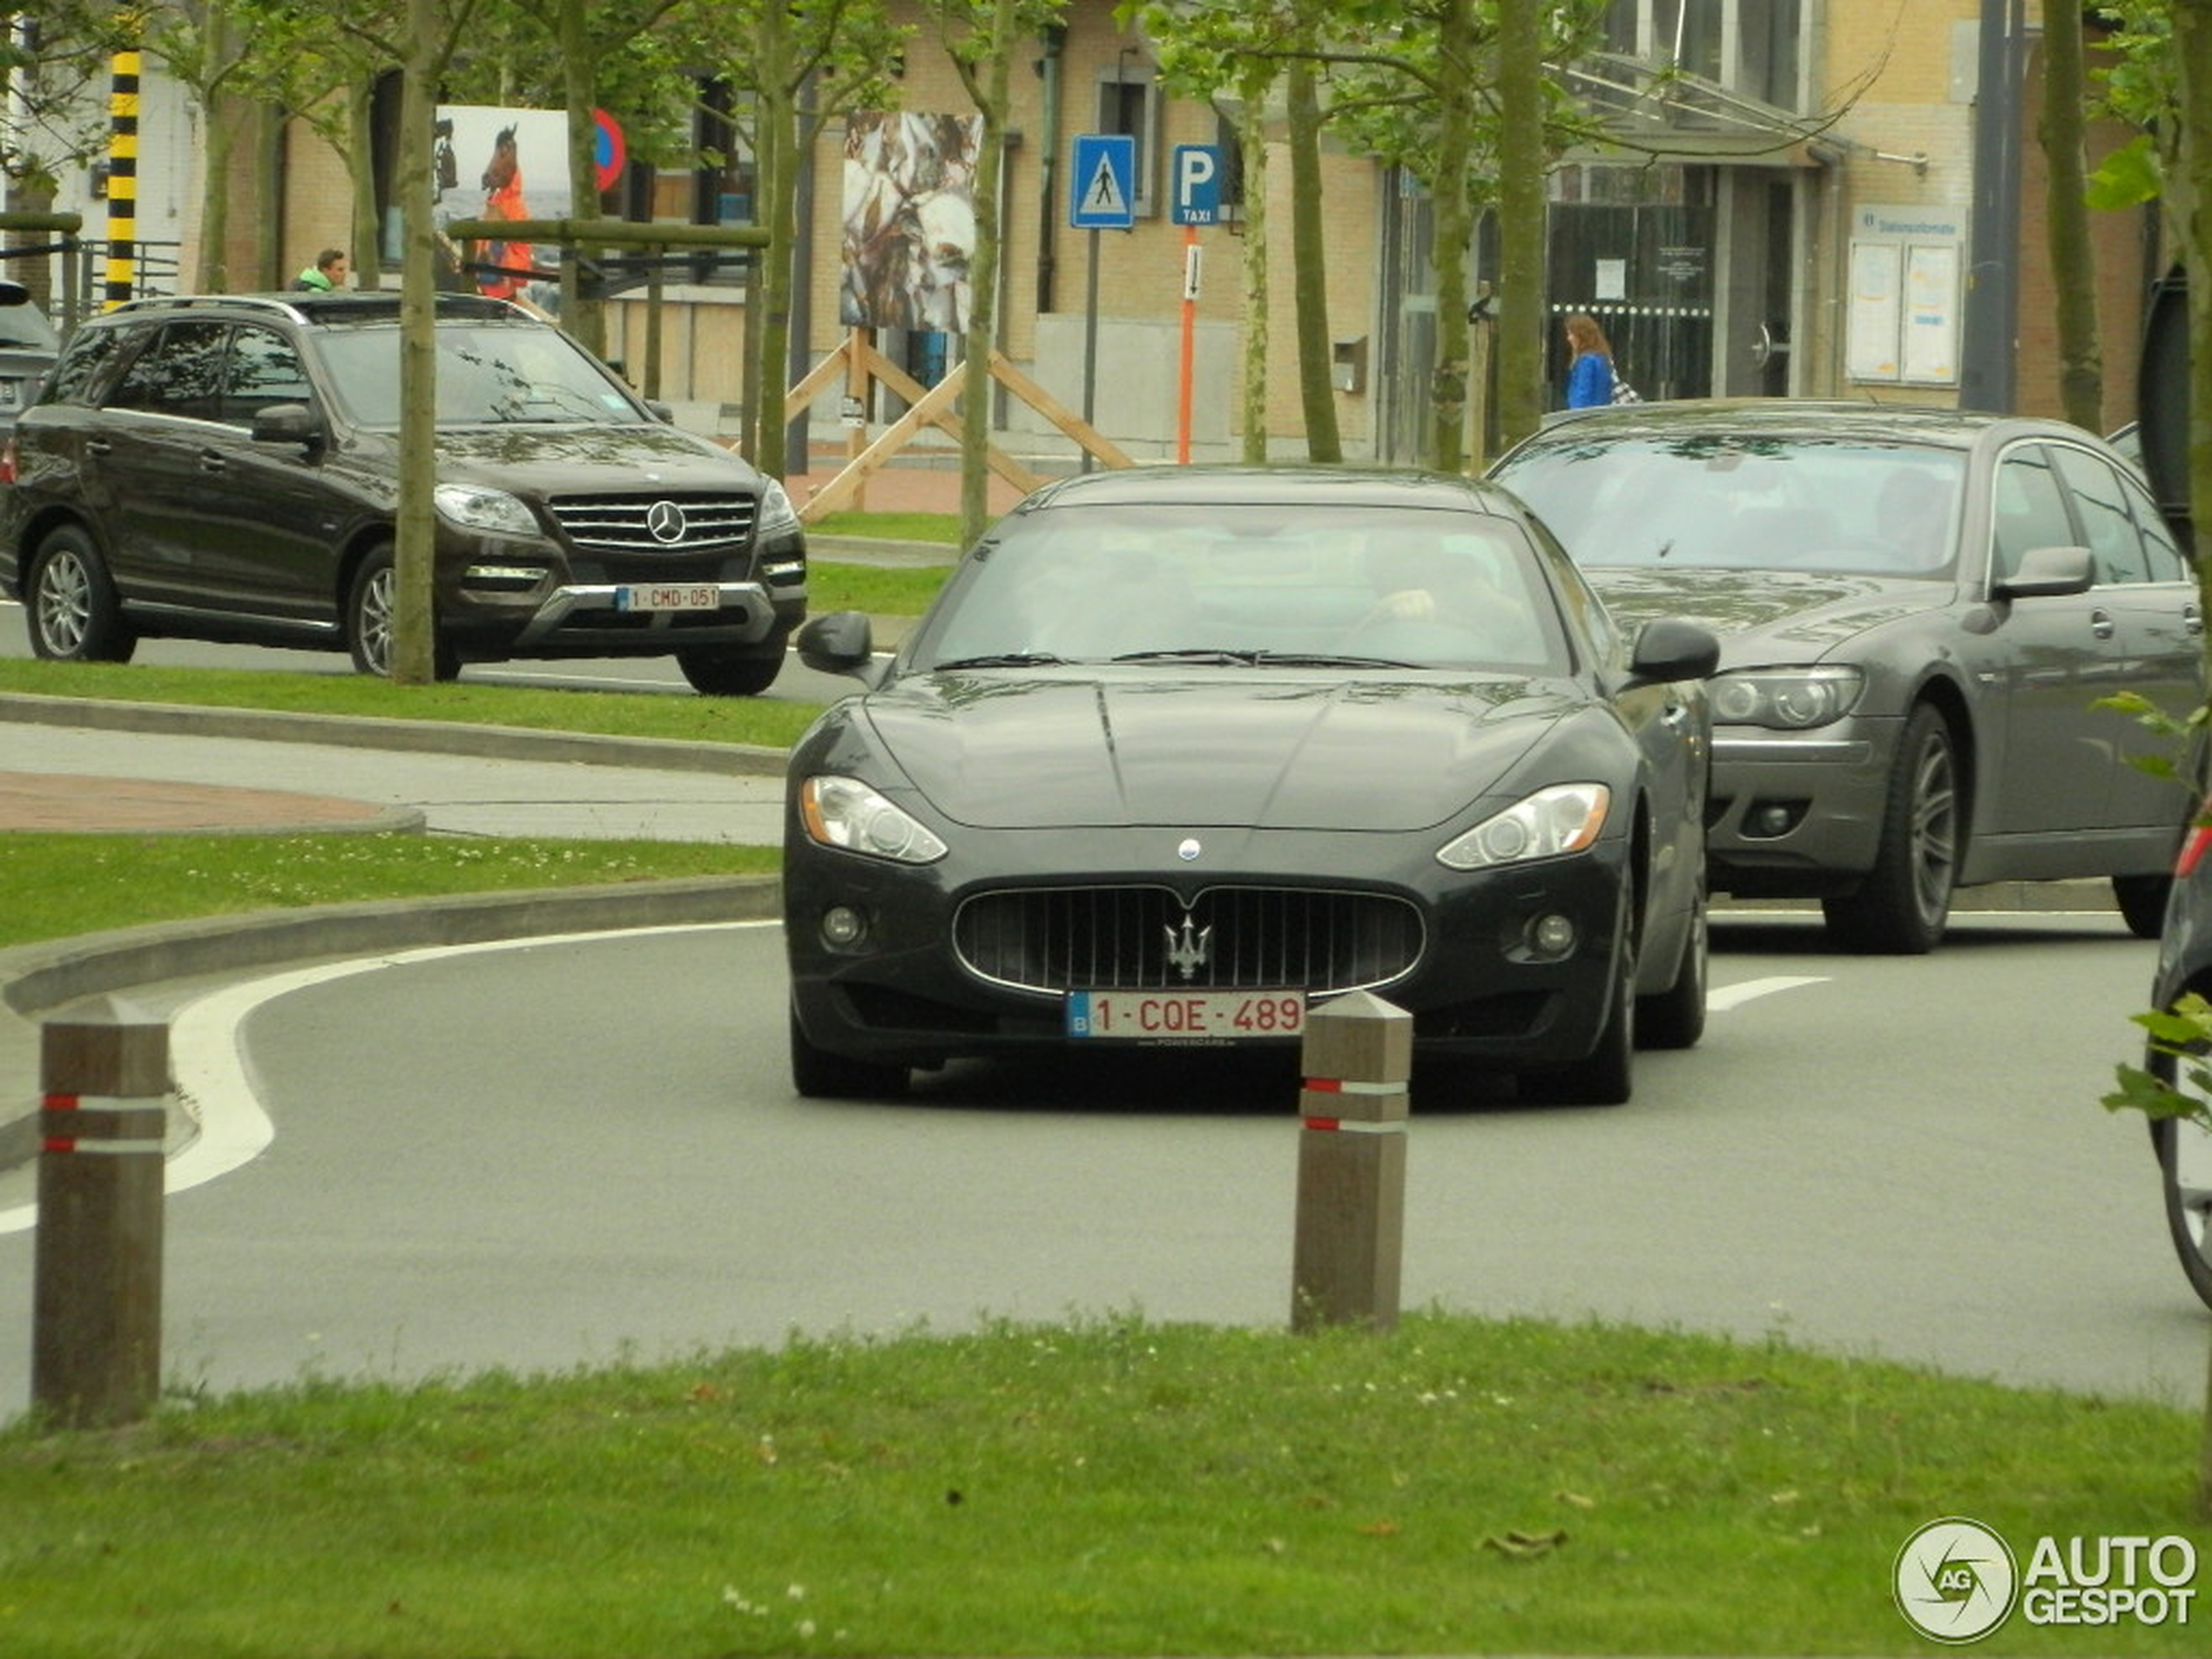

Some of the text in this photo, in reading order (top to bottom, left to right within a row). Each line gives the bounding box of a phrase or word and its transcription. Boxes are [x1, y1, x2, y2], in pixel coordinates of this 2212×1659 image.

[1181, 151, 1214, 206] P
[1184, 209, 1211, 223] TAXI
[1073, 1016, 1086, 1032] B
[1097, 999, 1300, 1031] 1-CQE-489
